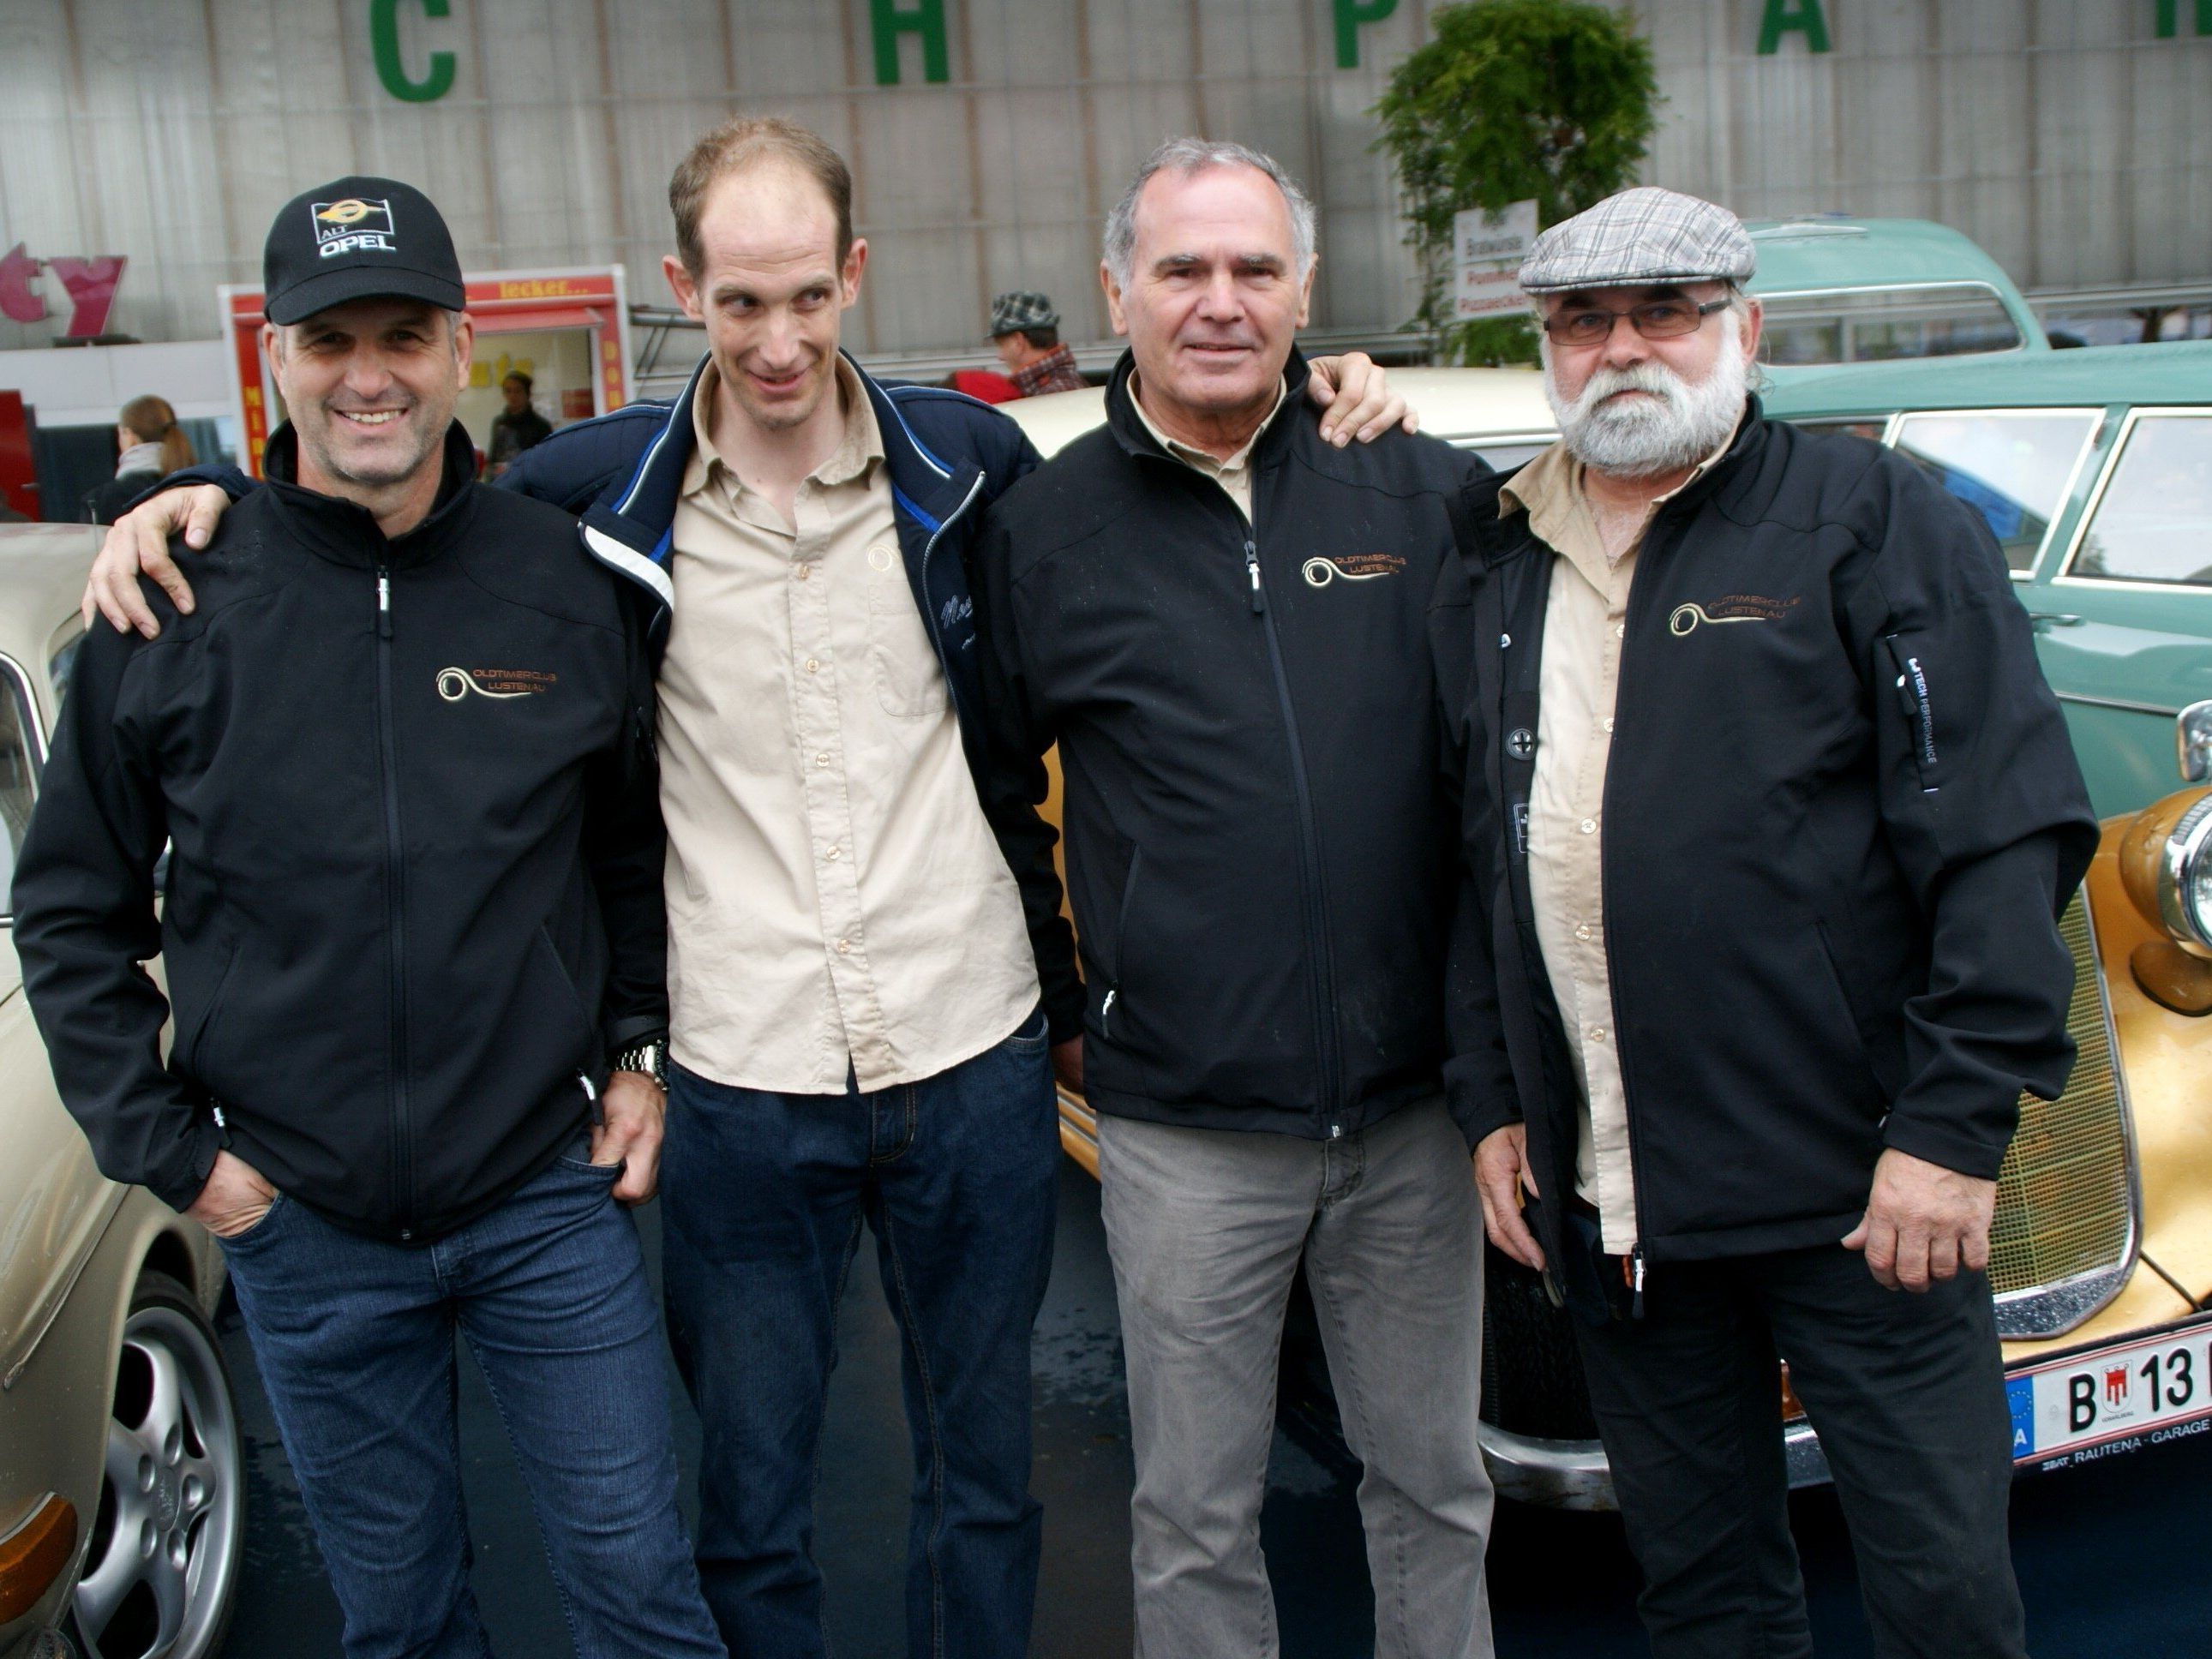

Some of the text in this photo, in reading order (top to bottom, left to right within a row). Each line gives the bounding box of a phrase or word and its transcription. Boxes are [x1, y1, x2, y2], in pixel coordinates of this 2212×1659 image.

[320, 235, 396, 257] OPEL
[321, 225, 348, 240] ALT
[1914, 671, 1938, 764] TECH PERFORMANCE
[2070, 1373, 2096, 1432] B
[2014, 1428, 2027, 1446] A
[2075, 1437, 2142, 1463] RAUTENA
[2151, 1418, 2210, 1443] GARAGE
